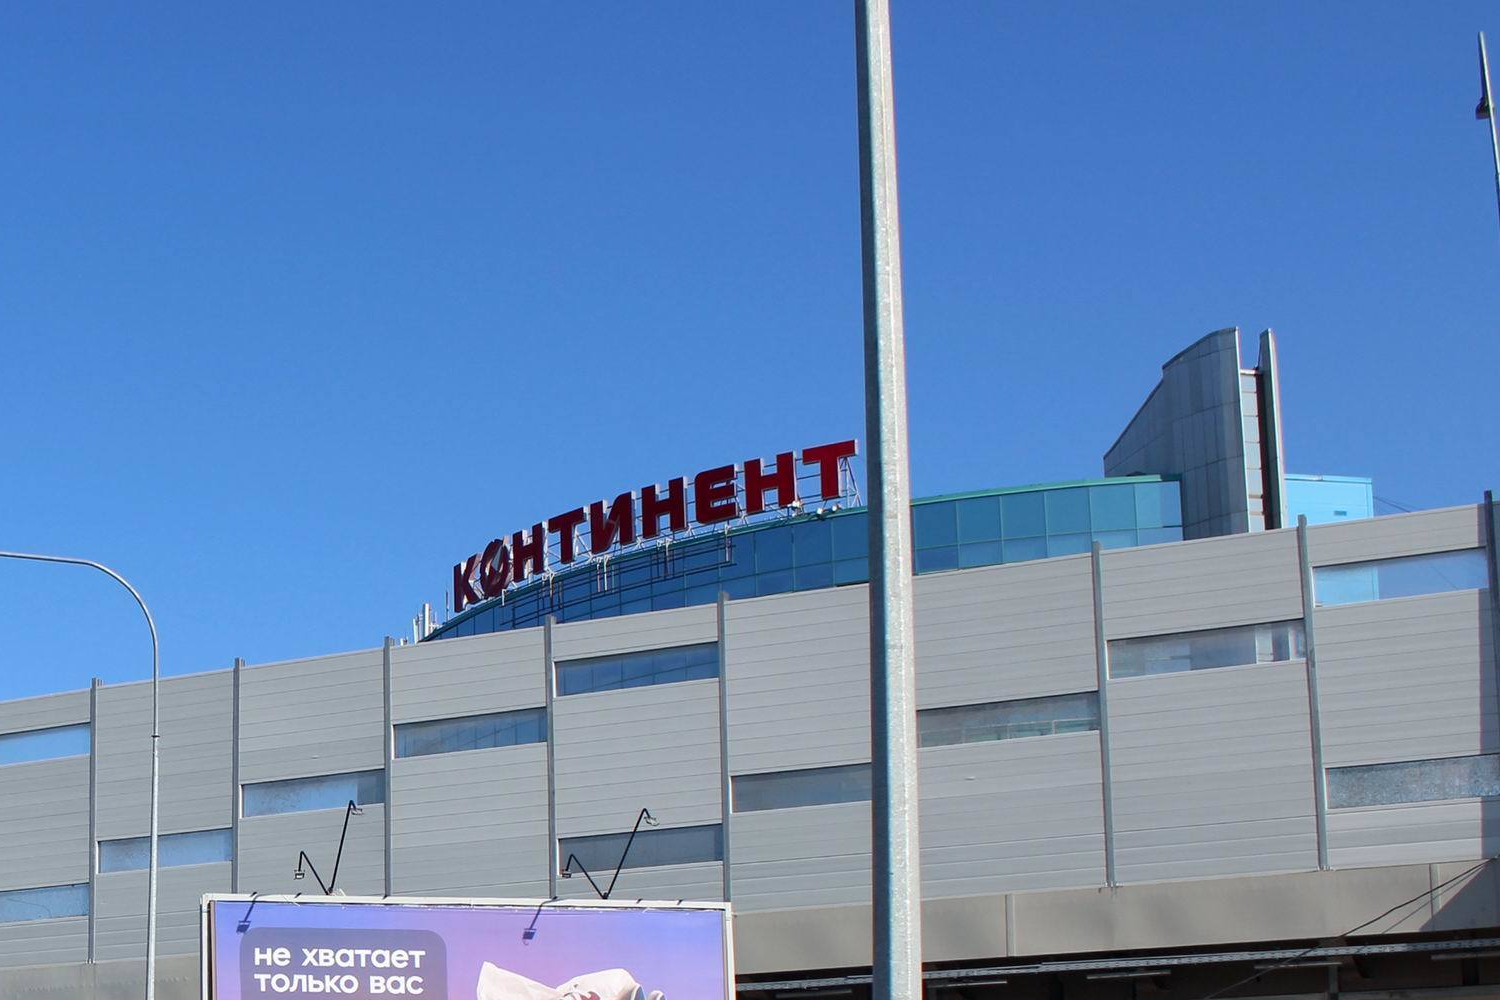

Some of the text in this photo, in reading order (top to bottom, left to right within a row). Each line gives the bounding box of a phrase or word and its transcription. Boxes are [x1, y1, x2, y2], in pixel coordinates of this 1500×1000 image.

[453, 440, 859, 613] КОНТИНЕНТ
[254, 947, 426, 968] не хватает
[254, 973, 424, 994] только вас
